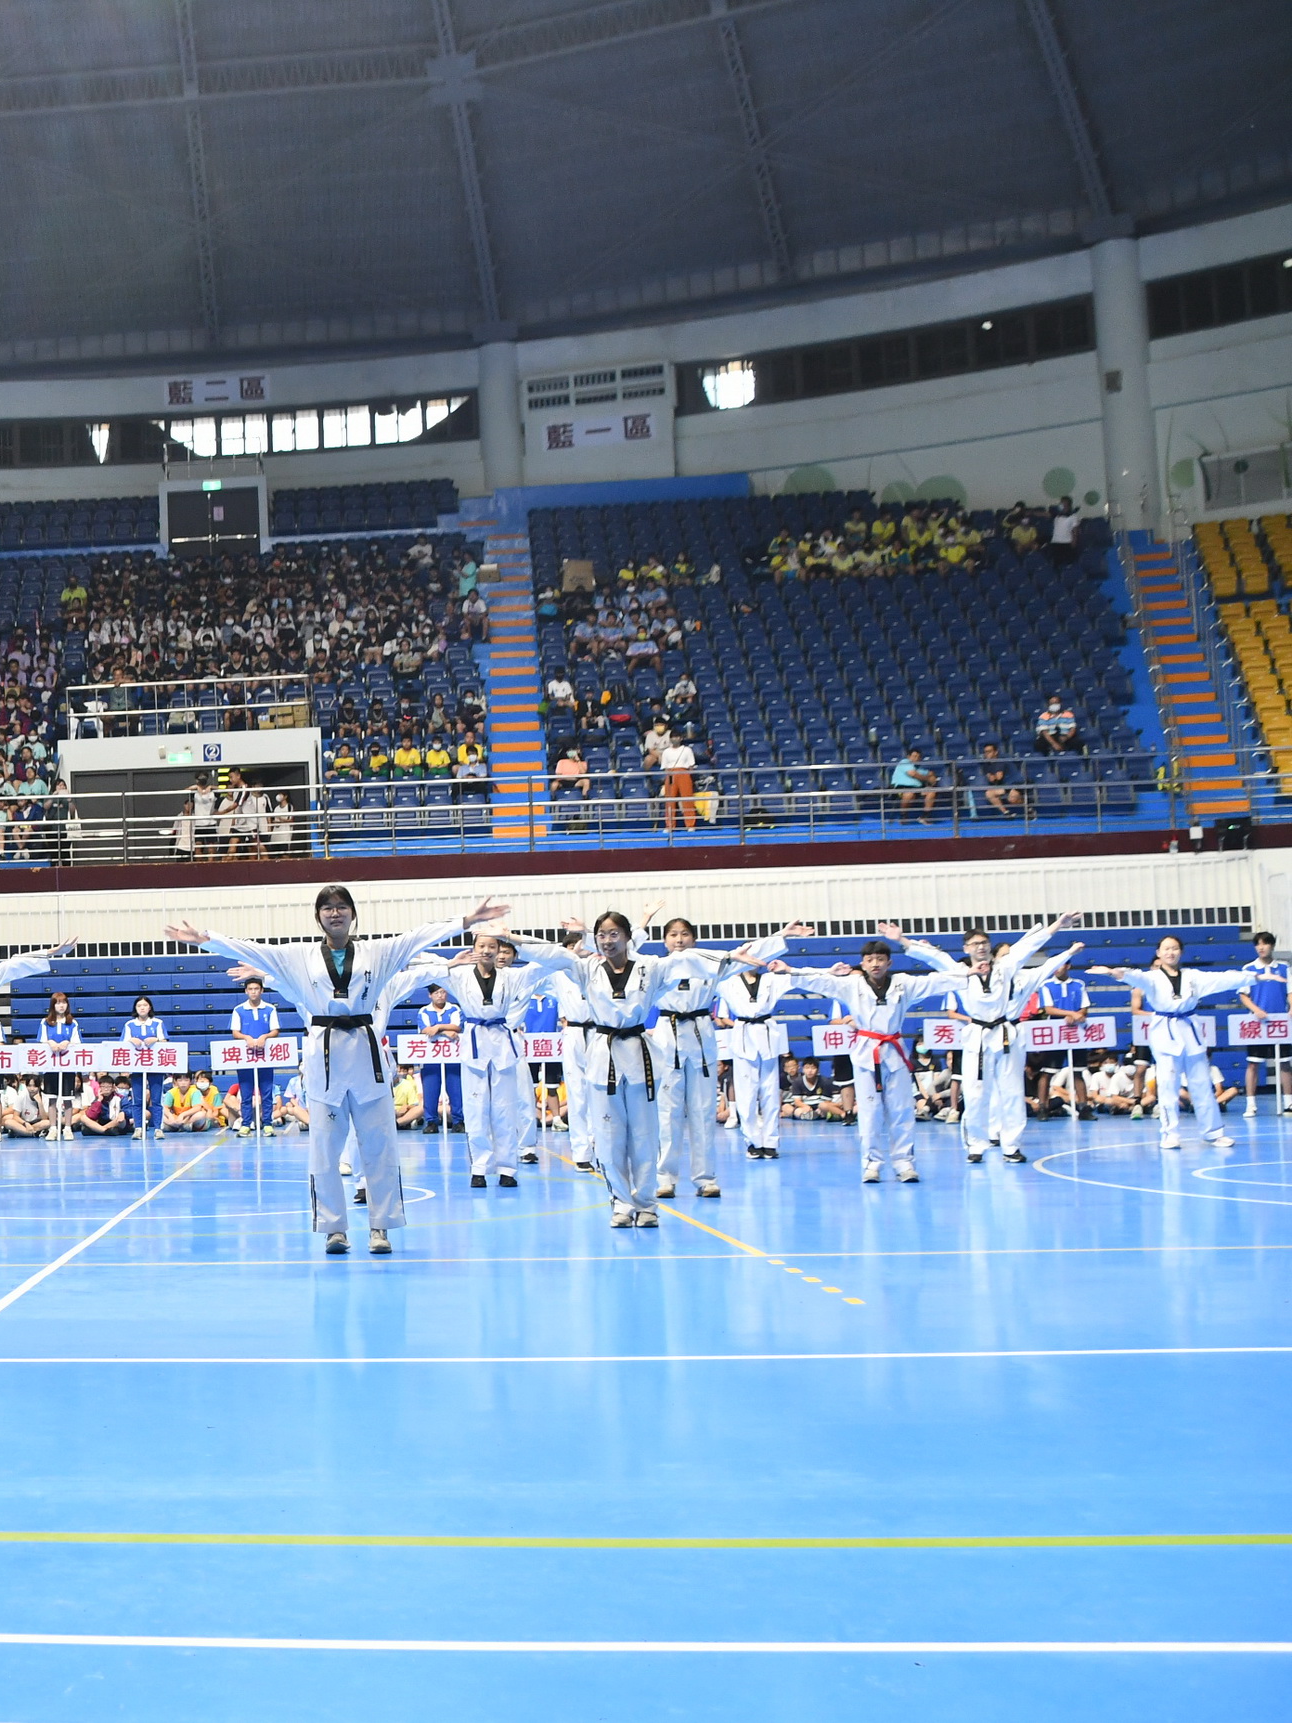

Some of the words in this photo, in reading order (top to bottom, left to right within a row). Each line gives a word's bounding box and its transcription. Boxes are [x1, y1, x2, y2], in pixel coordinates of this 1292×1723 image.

[168, 376, 265, 405] 藍二區
[547, 413, 652, 450] 藍一區
[1032, 1023, 1106, 1045] 田尾鄉
[27, 1048, 93, 1067] 彰化市
[111, 1048, 177, 1067] 鹿港鎮
[222, 1043, 291, 1064] 埤頭鄉
[407, 1039, 460, 1058] 芳苑
